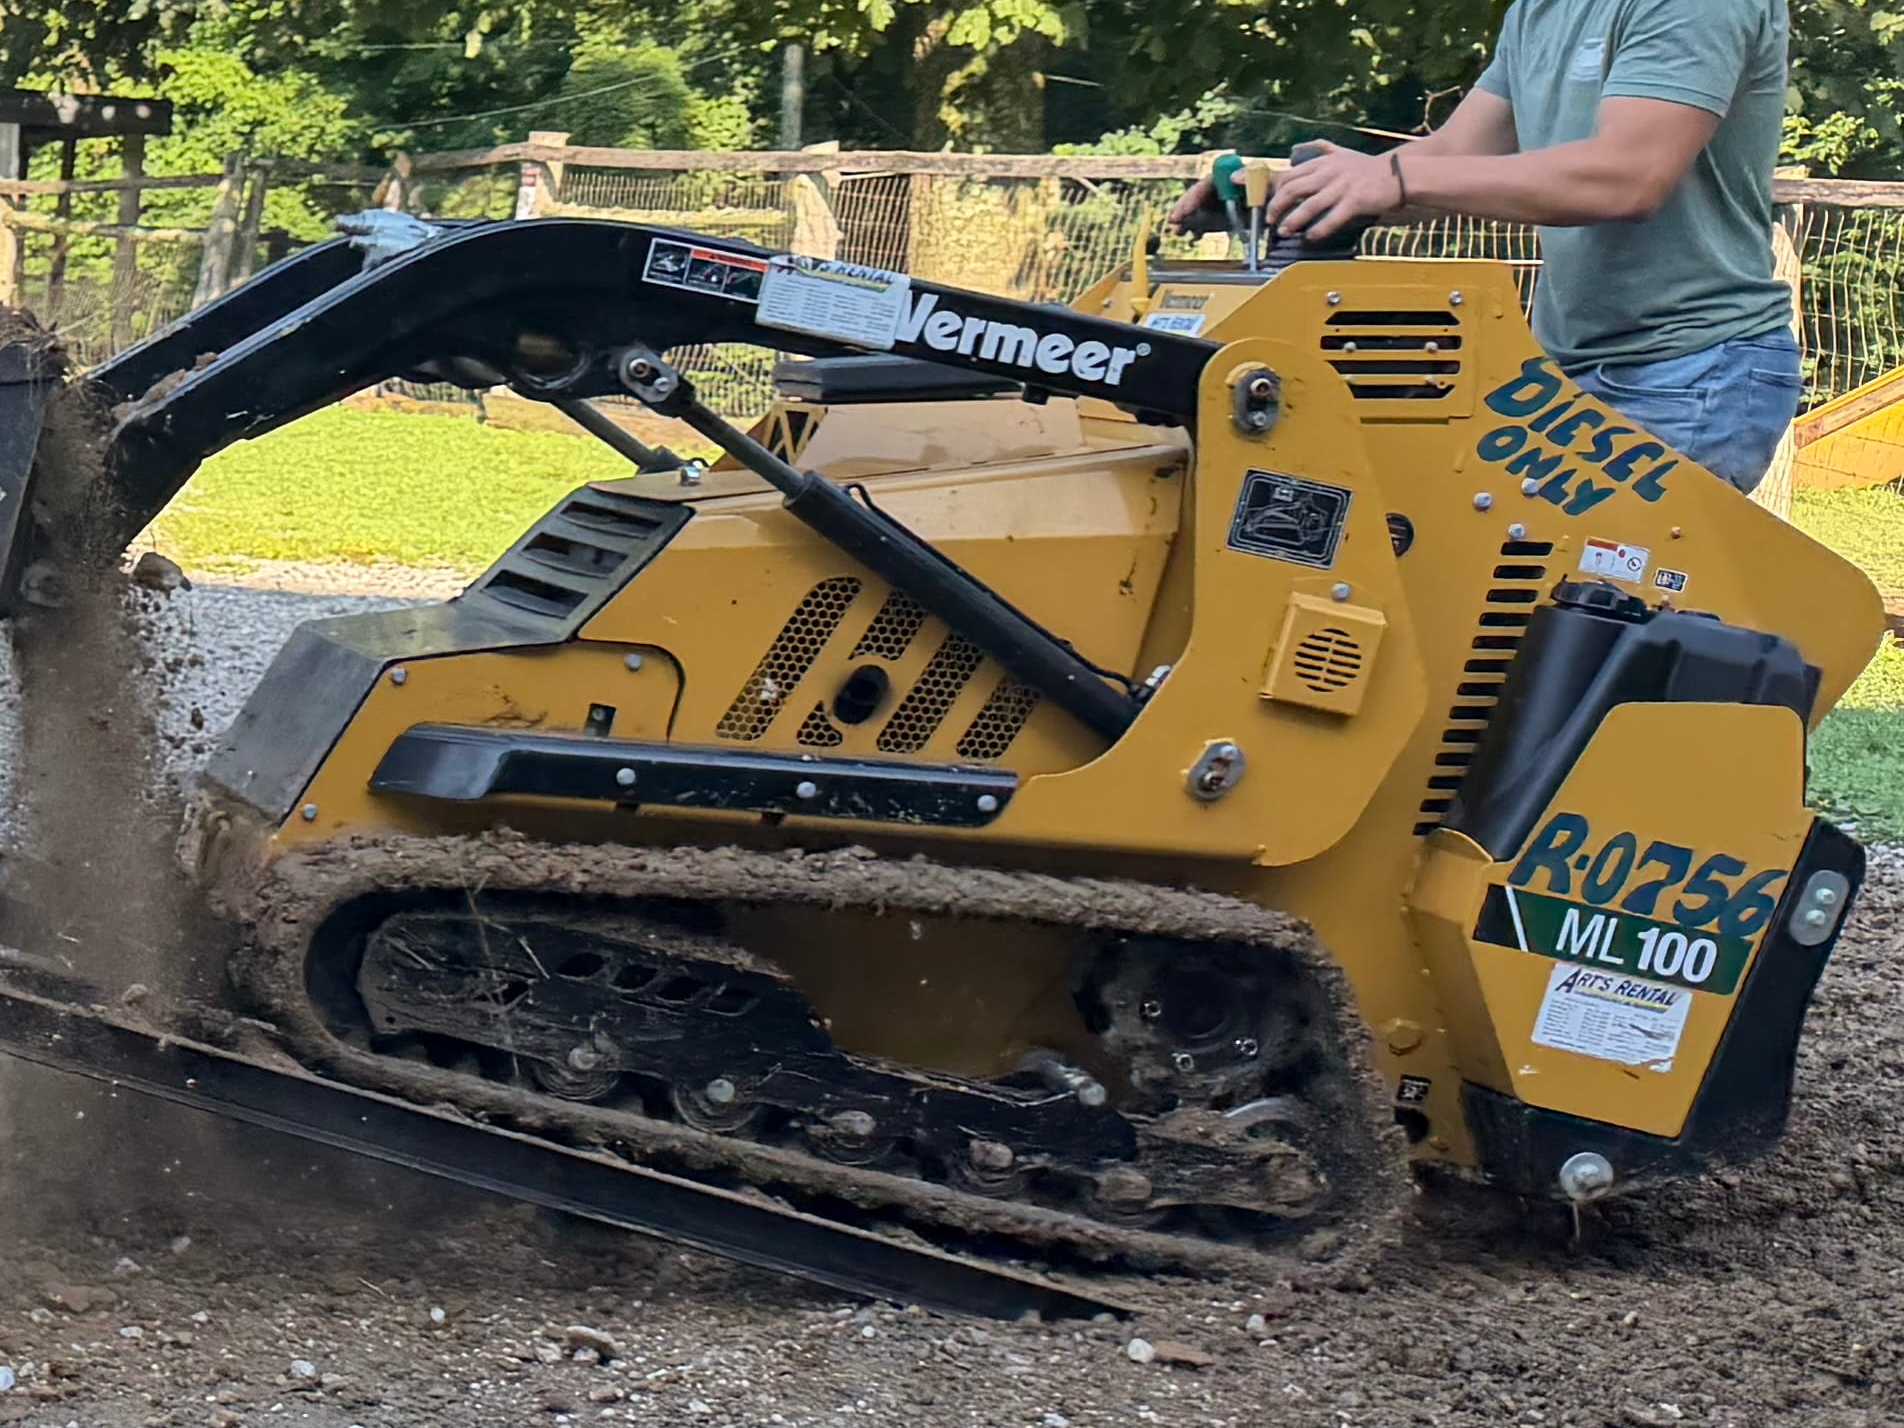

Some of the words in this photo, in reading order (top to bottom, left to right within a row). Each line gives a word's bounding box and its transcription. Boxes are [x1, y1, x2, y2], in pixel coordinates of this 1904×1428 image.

[894, 291, 1136, 386] Vermeer
[1477, 425, 1616, 515] ONLY
[1484, 356, 1680, 502] DIESEL
[1555, 907, 1624, 965] ML
[1637, 927, 1717, 983] 100
[1615, 980, 1678, 1005] RENTAL
